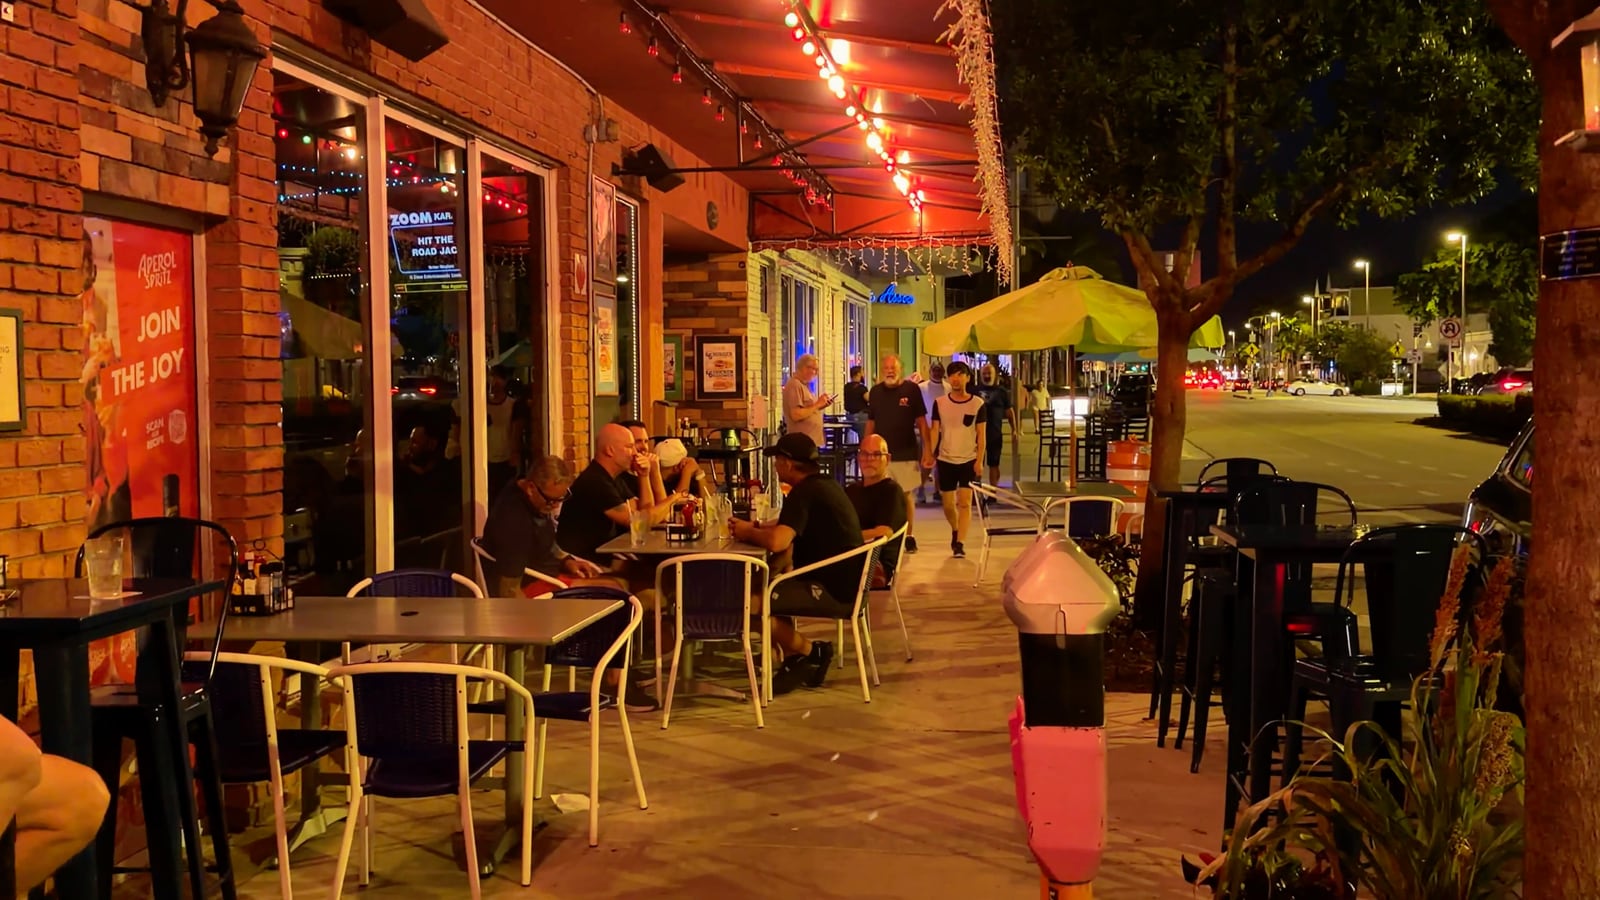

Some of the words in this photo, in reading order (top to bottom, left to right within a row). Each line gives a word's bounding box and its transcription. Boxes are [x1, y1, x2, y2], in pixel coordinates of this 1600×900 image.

[390, 212, 433, 226] ZOOM
[434, 212, 453, 221] KAR
[417, 236, 433, 246] HIT
[434, 235, 454, 245] THE
[412, 247, 437, 257] ROAD
[440, 246, 458, 255] JAC
[138, 251, 177, 279] APEROL
[137, 305, 181, 342] JOIN
[111, 360, 145, 396] THE
[149, 347, 184, 384] JOY
